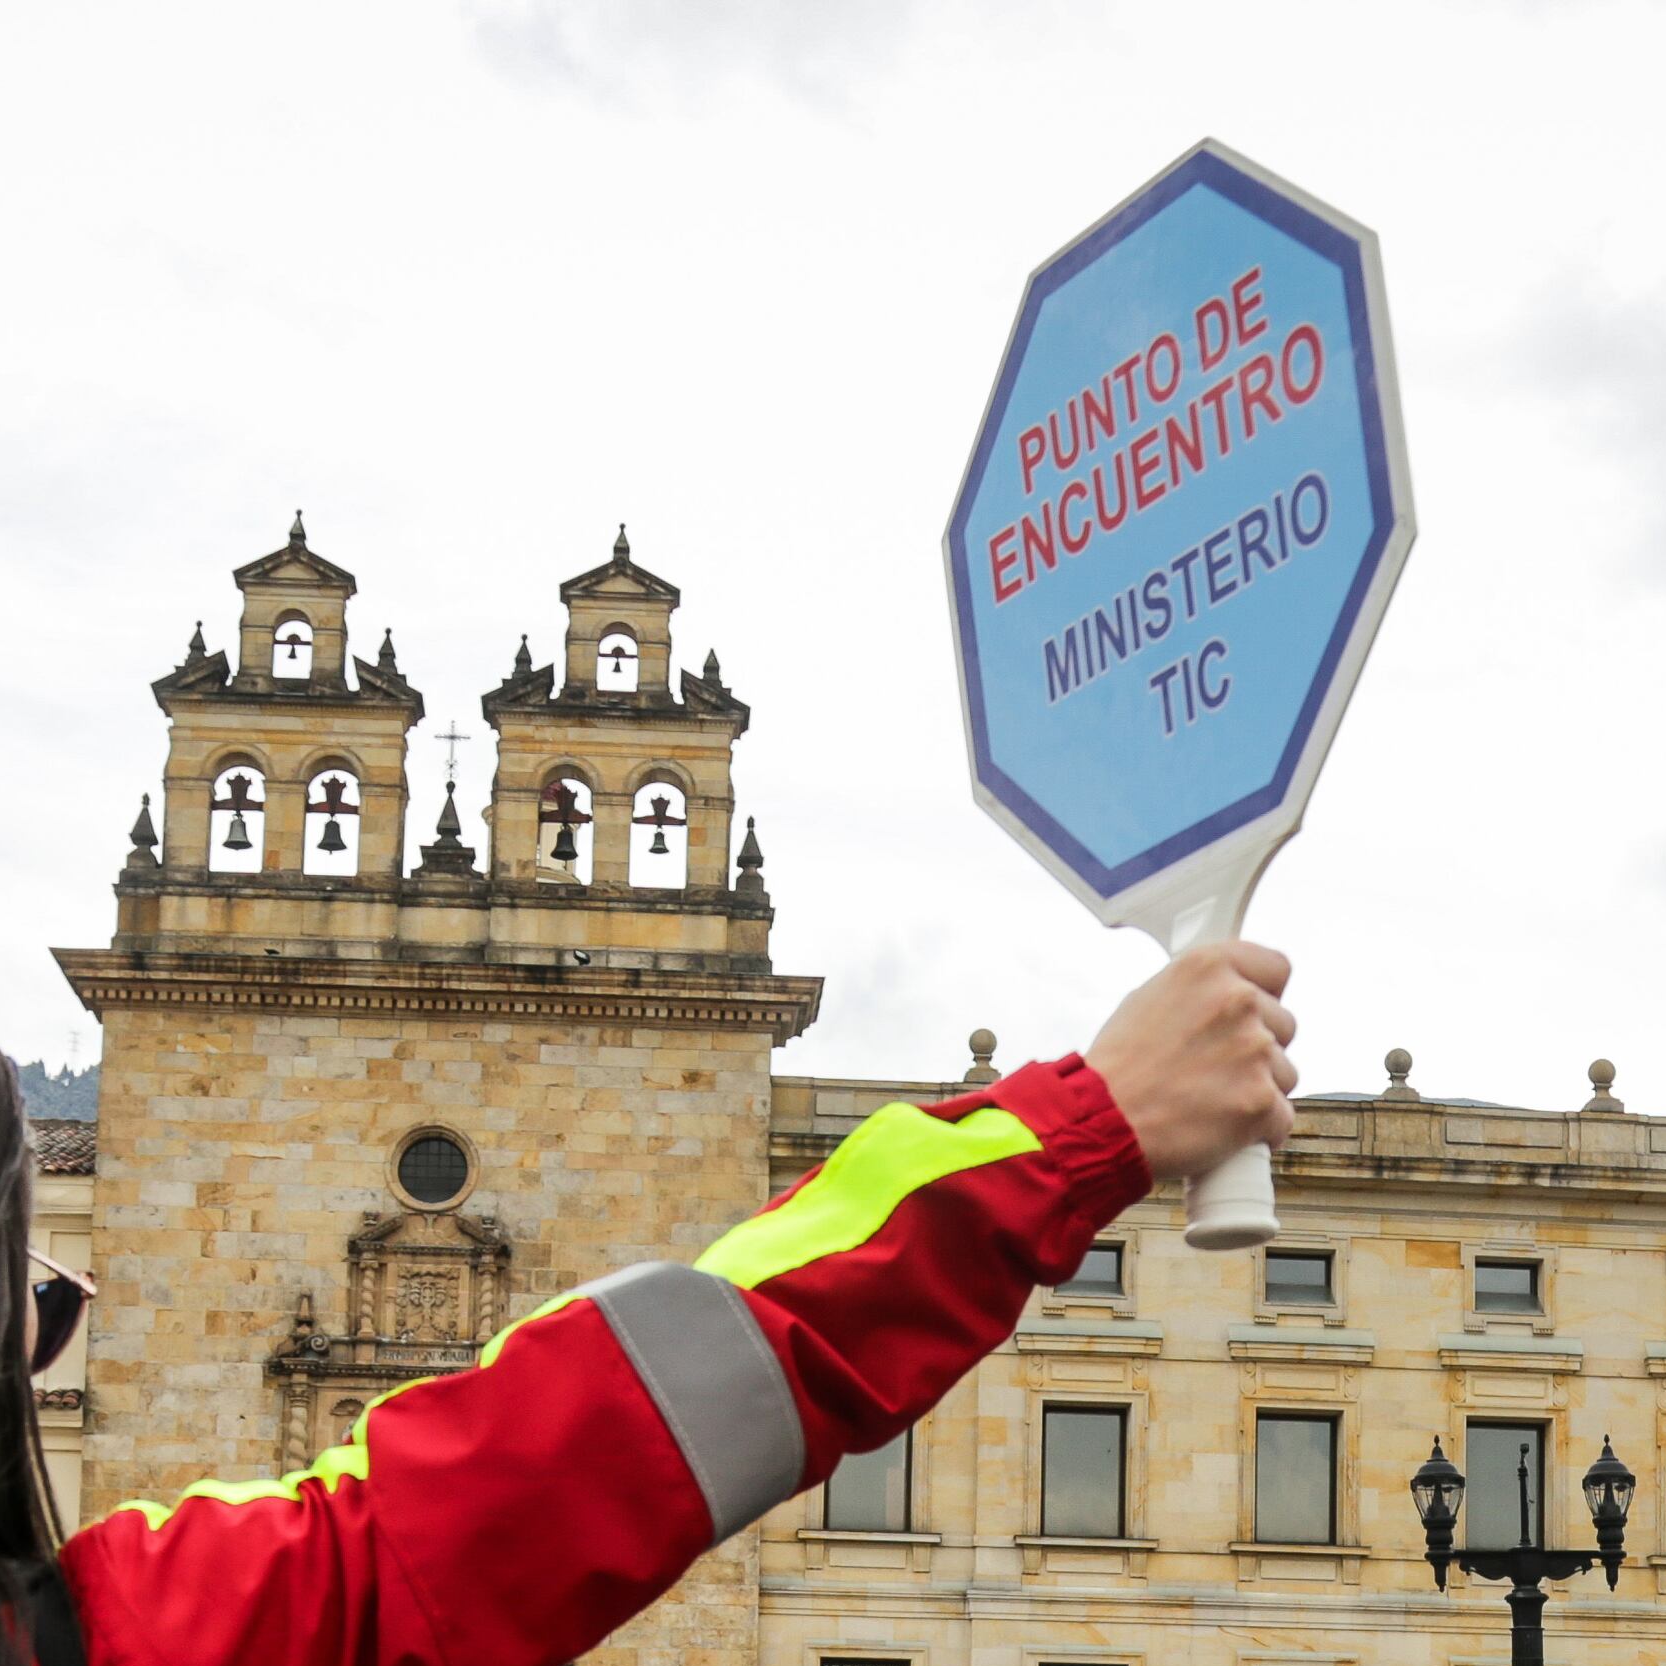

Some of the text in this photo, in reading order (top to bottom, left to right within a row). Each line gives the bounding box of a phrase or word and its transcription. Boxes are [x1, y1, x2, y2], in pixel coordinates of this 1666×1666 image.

[988, 323, 1325, 605] ENCUENTRO
[1017, 265, 1269, 495] PUNTO DE
[1042, 472, 1330, 703] MINISTERIO
[1149, 639, 1232, 737] TIC
